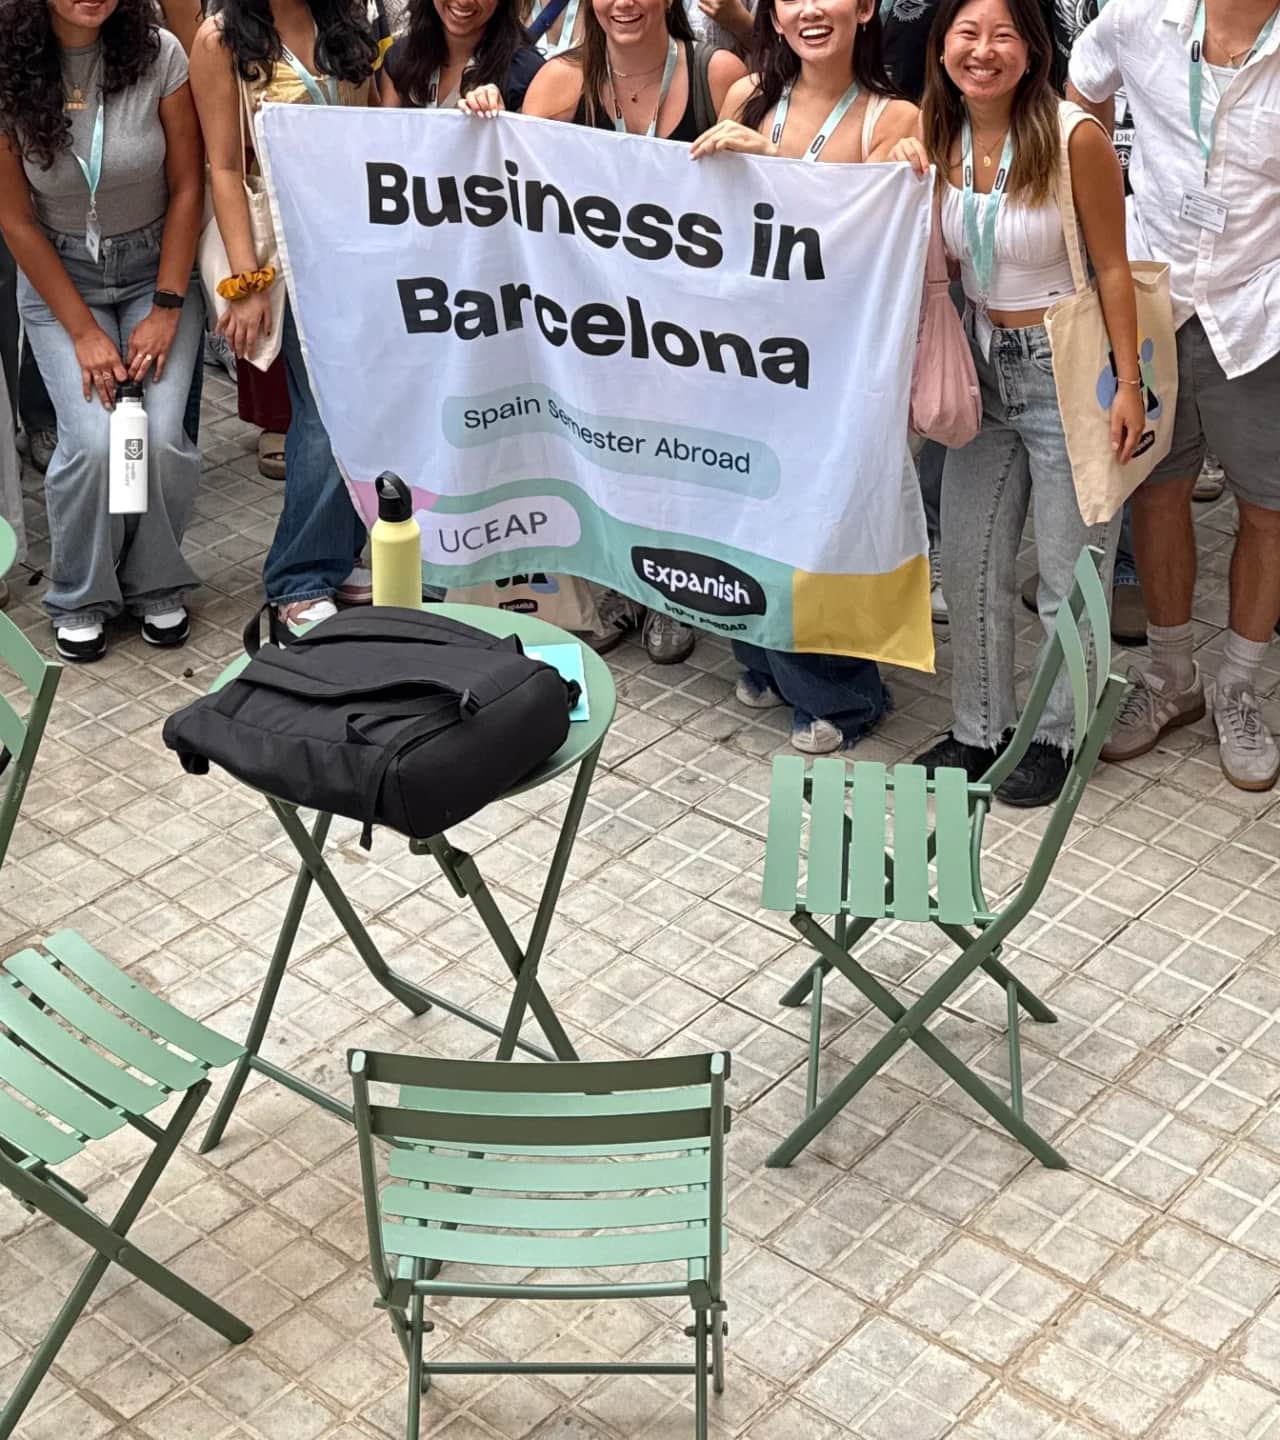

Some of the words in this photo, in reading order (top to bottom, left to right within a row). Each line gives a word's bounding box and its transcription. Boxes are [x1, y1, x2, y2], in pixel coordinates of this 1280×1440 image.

[365, 160, 723, 269] Business
[750, 202, 826, 281] in
[397, 275, 810, 390] Barcelona
[464, 396, 541, 430] Spain
[548, 399, 646, 454] Semester
[654, 437, 750, 475] Abroad
[438, 510, 548, 553] UCEAP
[642, 558, 751, 605] Expanish
